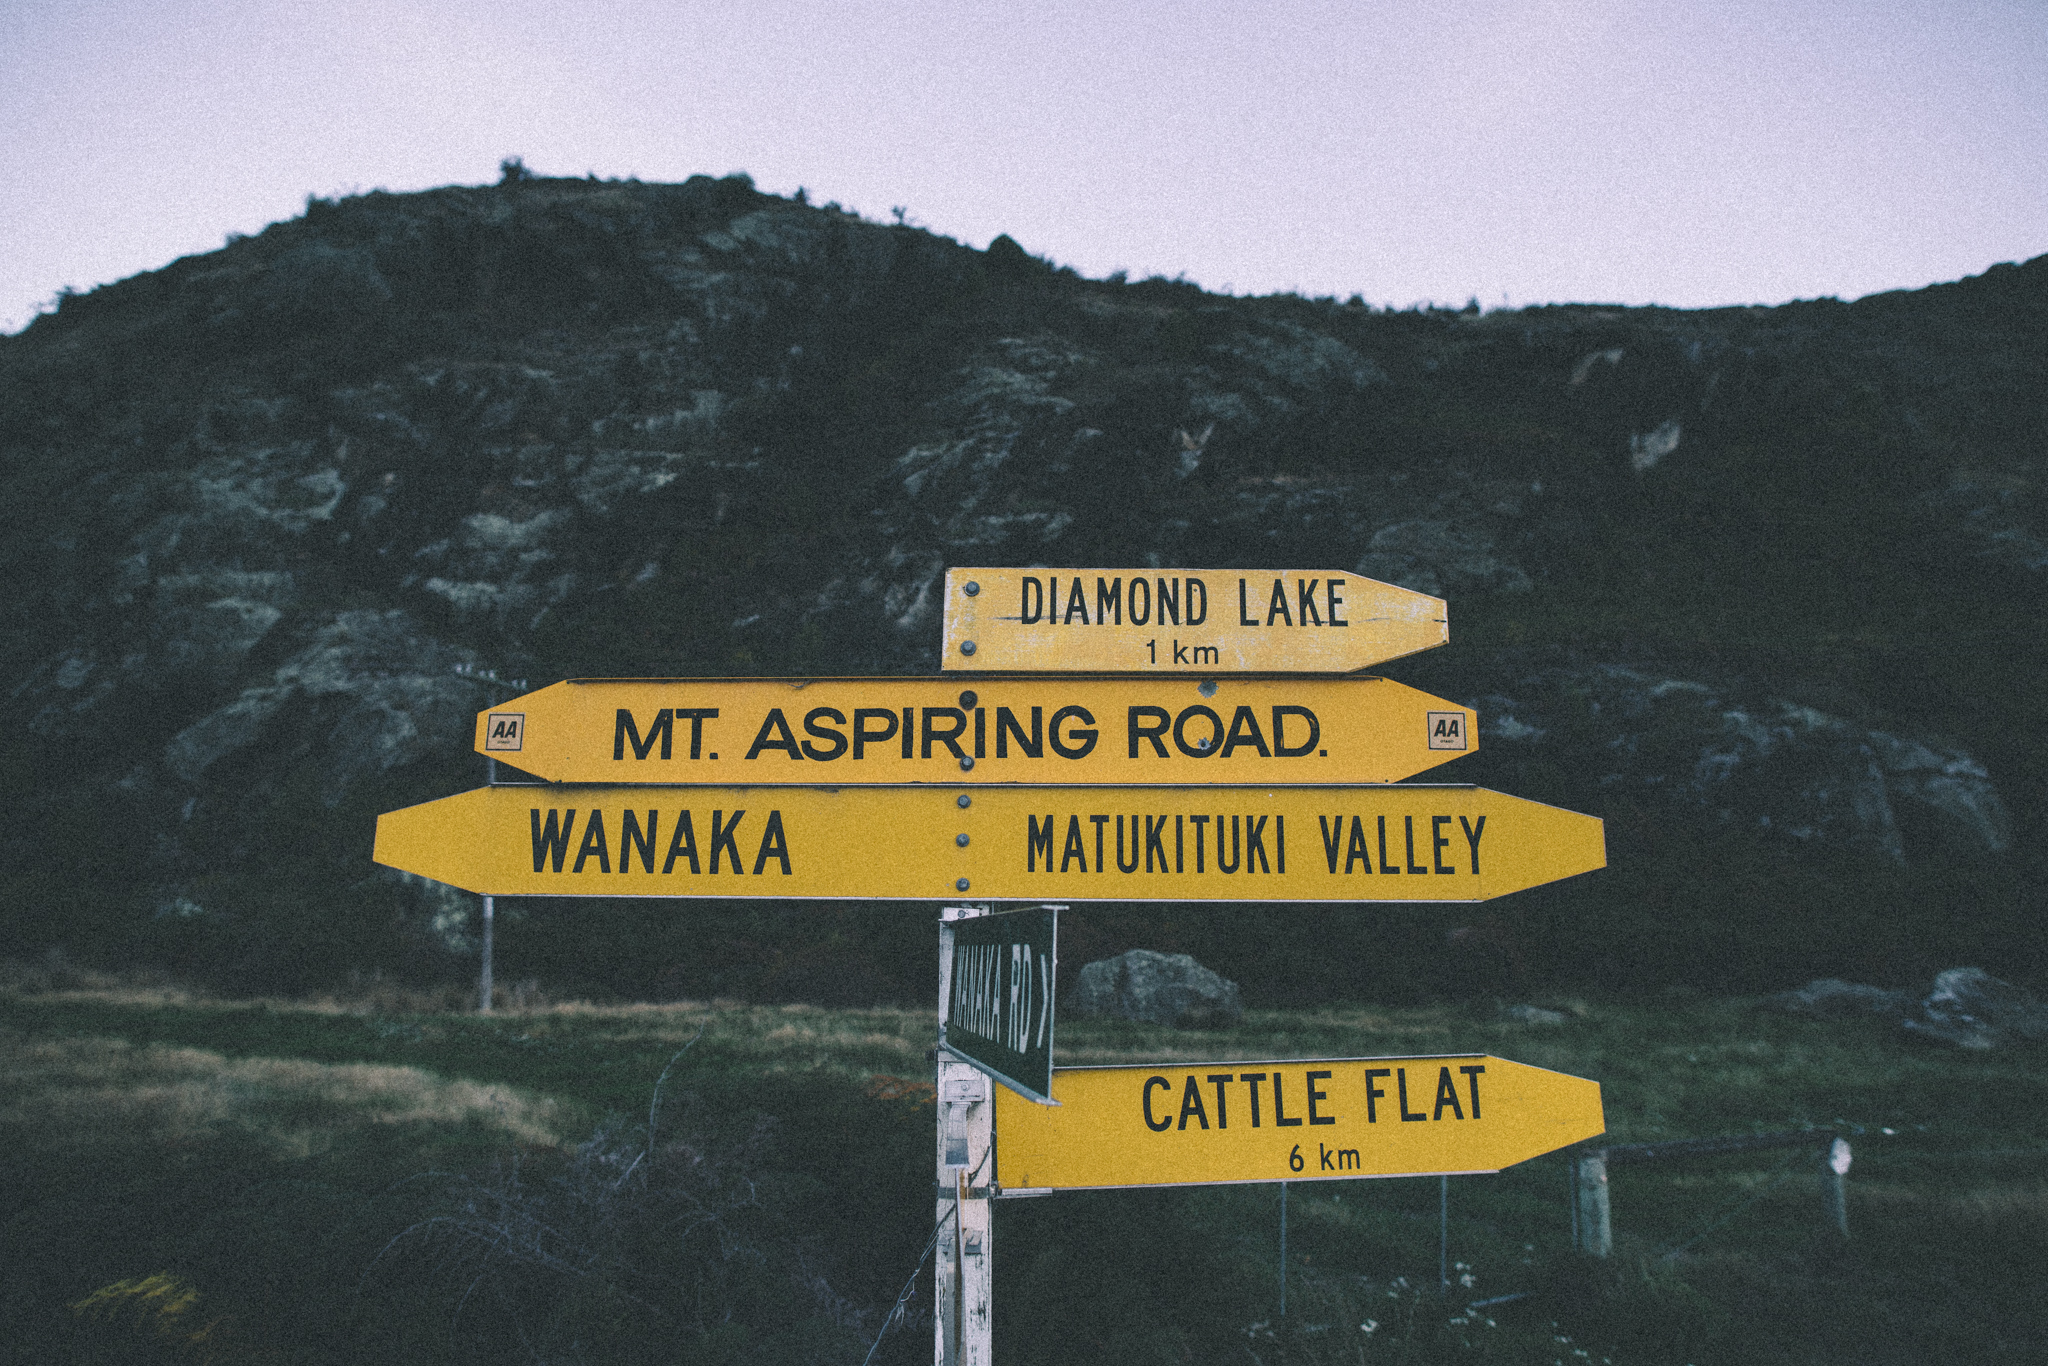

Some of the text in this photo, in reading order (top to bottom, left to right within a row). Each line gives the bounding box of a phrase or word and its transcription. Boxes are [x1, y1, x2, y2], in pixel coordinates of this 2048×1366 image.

[1021, 576, 1348, 627] DIAMOND LAKE
[1146, 640, 1219, 664] 1 km
[492, 721, 517, 738] AA
[613, 705, 1327, 761] MT. ASPIRING ROAD.
[1434, 719, 1459, 737] AA
[530, 809, 792, 875] WANAKA
[1027, 814, 1486, 875] MATUKITUKI VALLEY
[954, 944, 1032, 1054] WANAKA RD
[1143, 1065, 1486, 1132] CATTLE FLAT
[1289, 1143, 1361, 1172] 6 km
